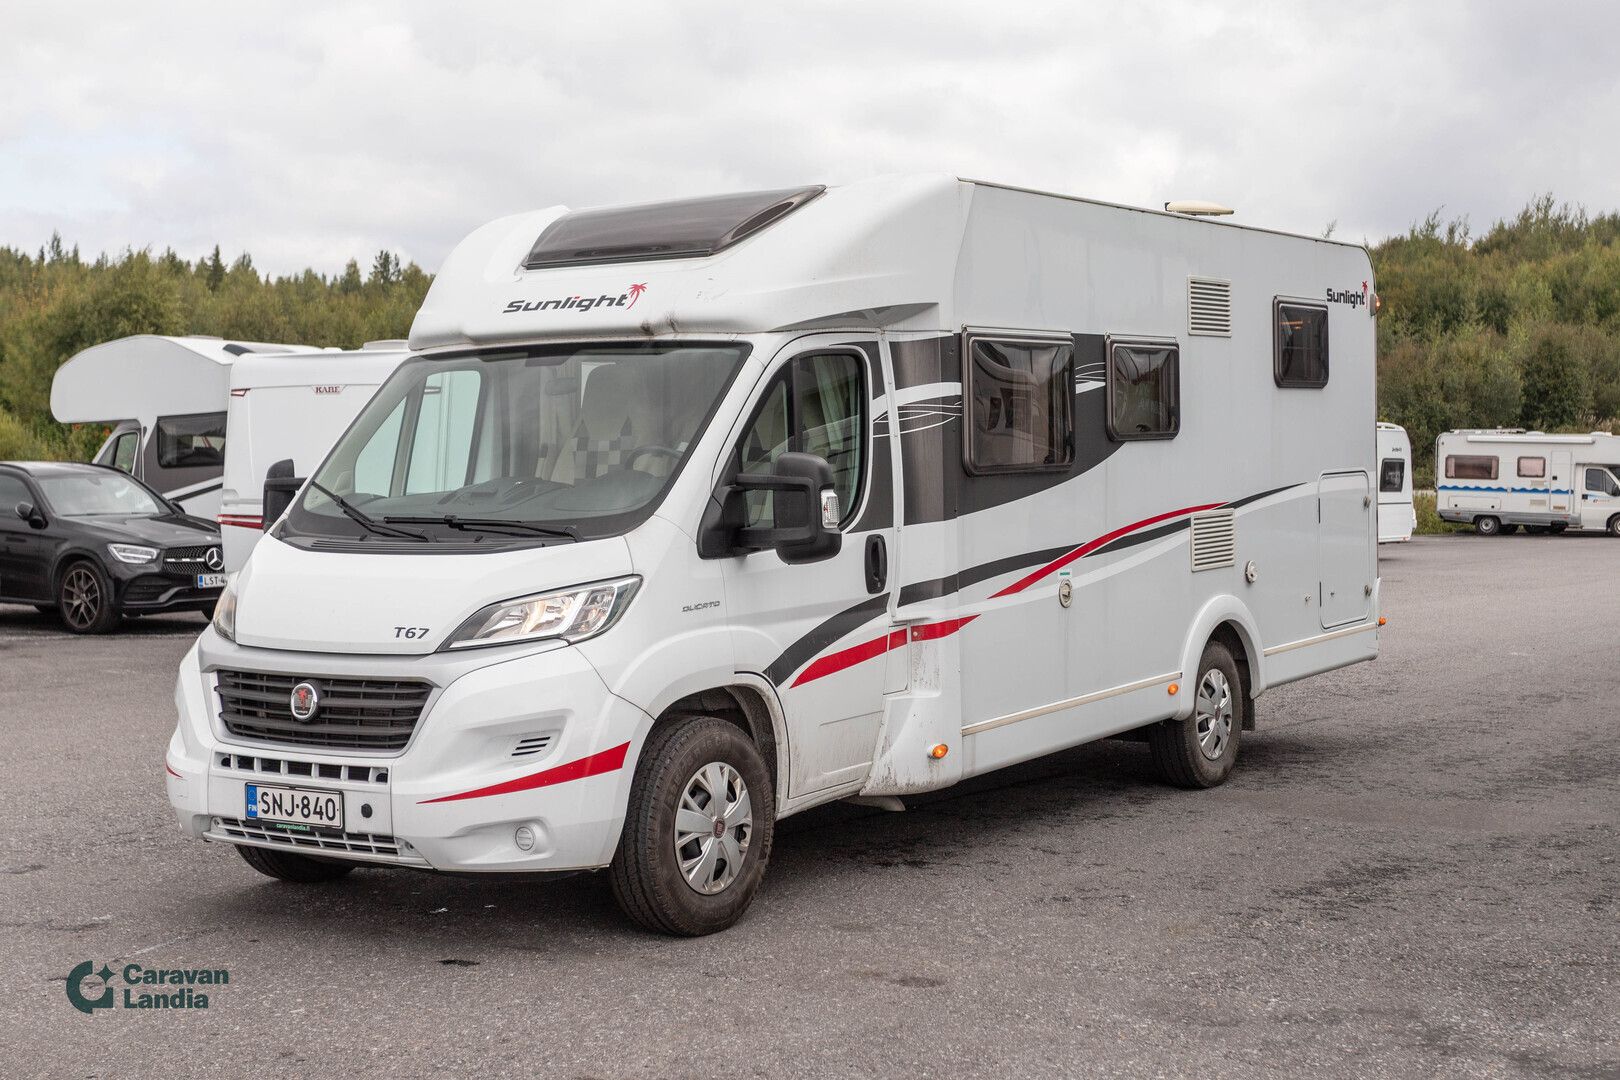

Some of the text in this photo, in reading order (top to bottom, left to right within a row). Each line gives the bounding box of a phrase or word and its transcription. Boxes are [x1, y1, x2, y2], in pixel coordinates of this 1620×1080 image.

[502, 294, 628, 313] Sunlight
[1326, 288, 1365, 309] Sunlight
[204, 576, 227, 586] LST-4
[394, 626, 430, 639] T67
[260, 791, 336, 821] SNJ-840
